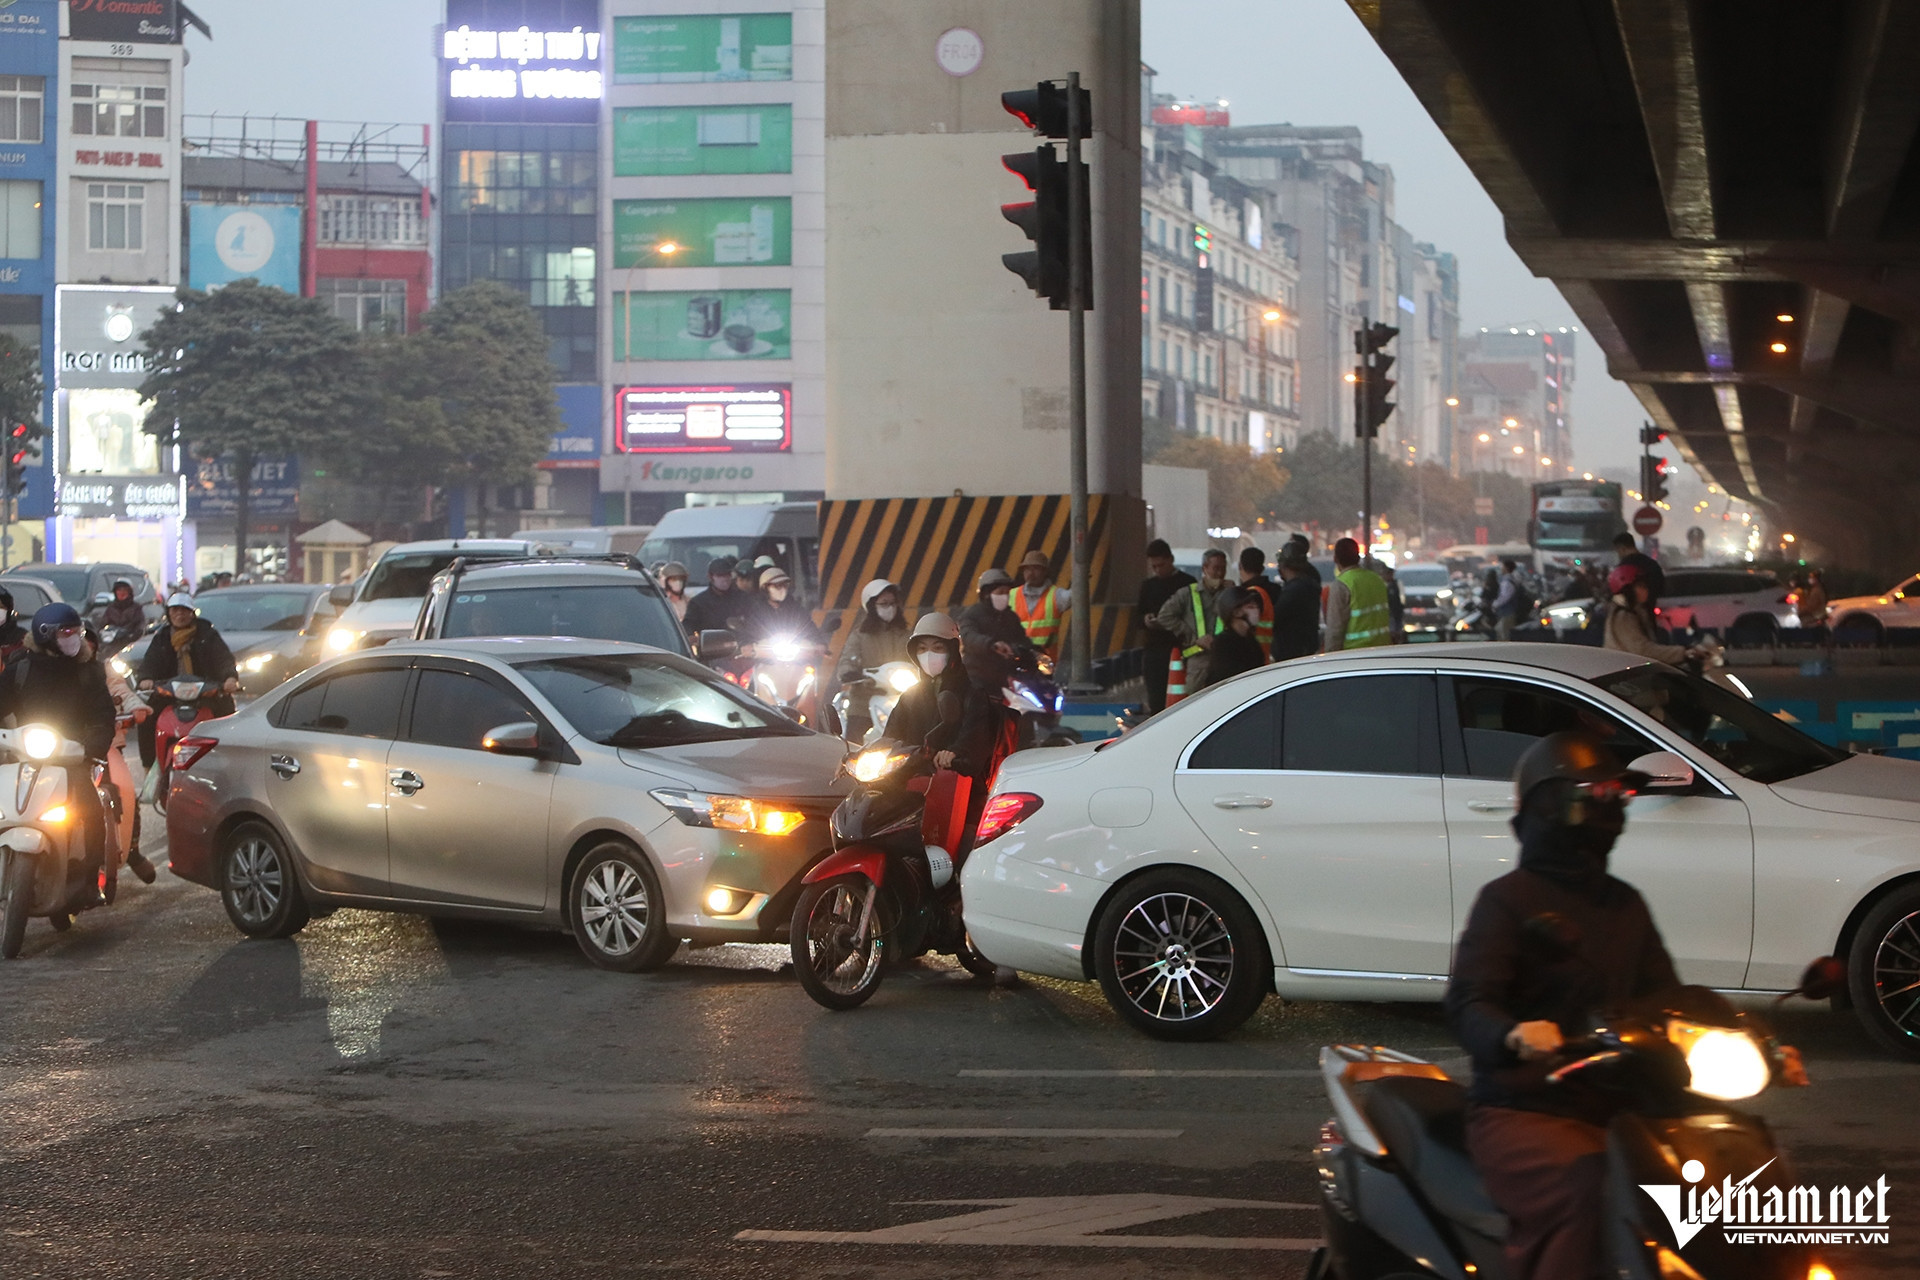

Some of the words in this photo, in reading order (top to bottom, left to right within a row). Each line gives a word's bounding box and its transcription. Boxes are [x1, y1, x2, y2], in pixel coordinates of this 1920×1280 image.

[138, 20, 171, 36] Studio
[110, 43, 134, 56] 369
[498, 25, 544, 66] VIỆN
[545, 26, 584, 61] THÚ
[584, 32, 601, 61] Y
[942, 43, 977, 59] FR04
[640, 461, 754, 484] Kangaroo
